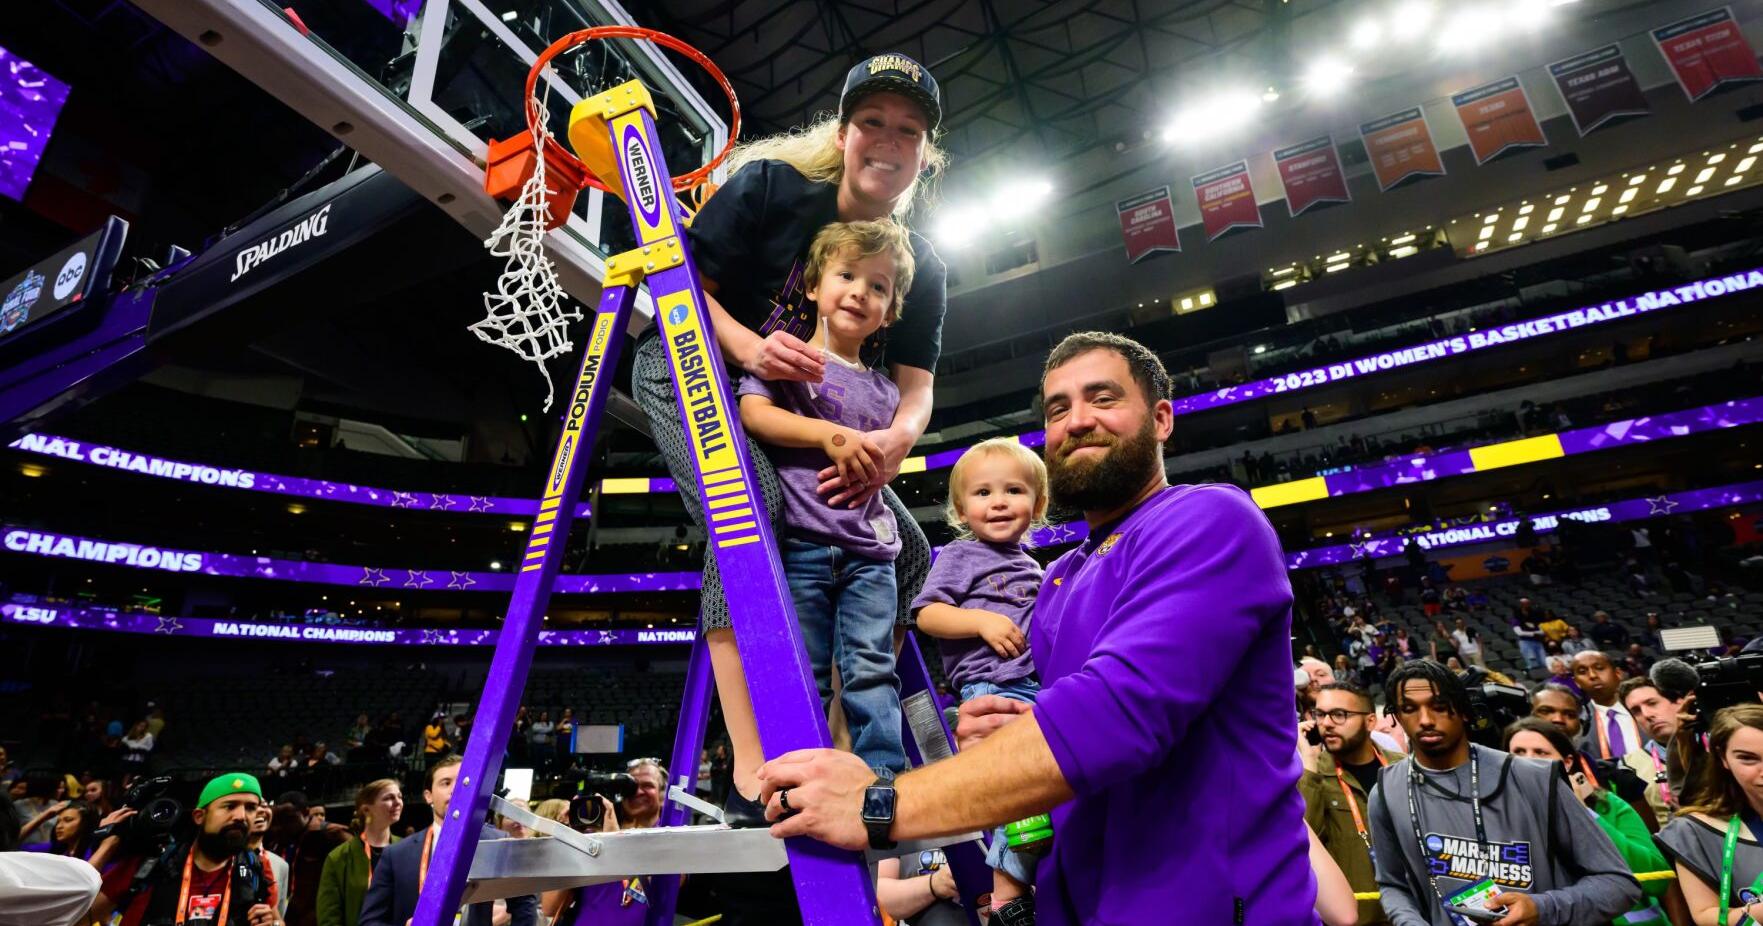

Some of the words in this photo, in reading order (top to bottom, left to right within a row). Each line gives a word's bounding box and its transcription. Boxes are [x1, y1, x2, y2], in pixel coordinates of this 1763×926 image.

[629, 142, 656, 208] WERNER
[231, 203, 332, 283] SPALDING
[57, 264, 83, 287] abc
[1272, 369, 1328, 393] 2023
[1329, 362, 1354, 381] DI
[1355, 337, 1467, 375] WOMEN'S
[1468, 300, 1637, 349] BASKETBALL
[1636, 269, 1763, 311] NATIONA
[567, 354, 601, 431] PODIUM
[593, 318, 609, 352] PODIO
[673, 329, 727, 460] BASKETBALL
[8, 433, 85, 461] NAL
[89, 446, 256, 489] CHAMPIONS
[1495, 507, 1612, 536] CHMPONS
[4, 530, 203, 572] CHAMPIONS
[13, 607, 57, 624] LSU
[213, 622, 301, 640] NATIONAL
[302, 626, 396, 643] CHAMPIONS
[637, 630, 697, 642] NATIONA
[1451, 855, 1533, 882] MADNESS
